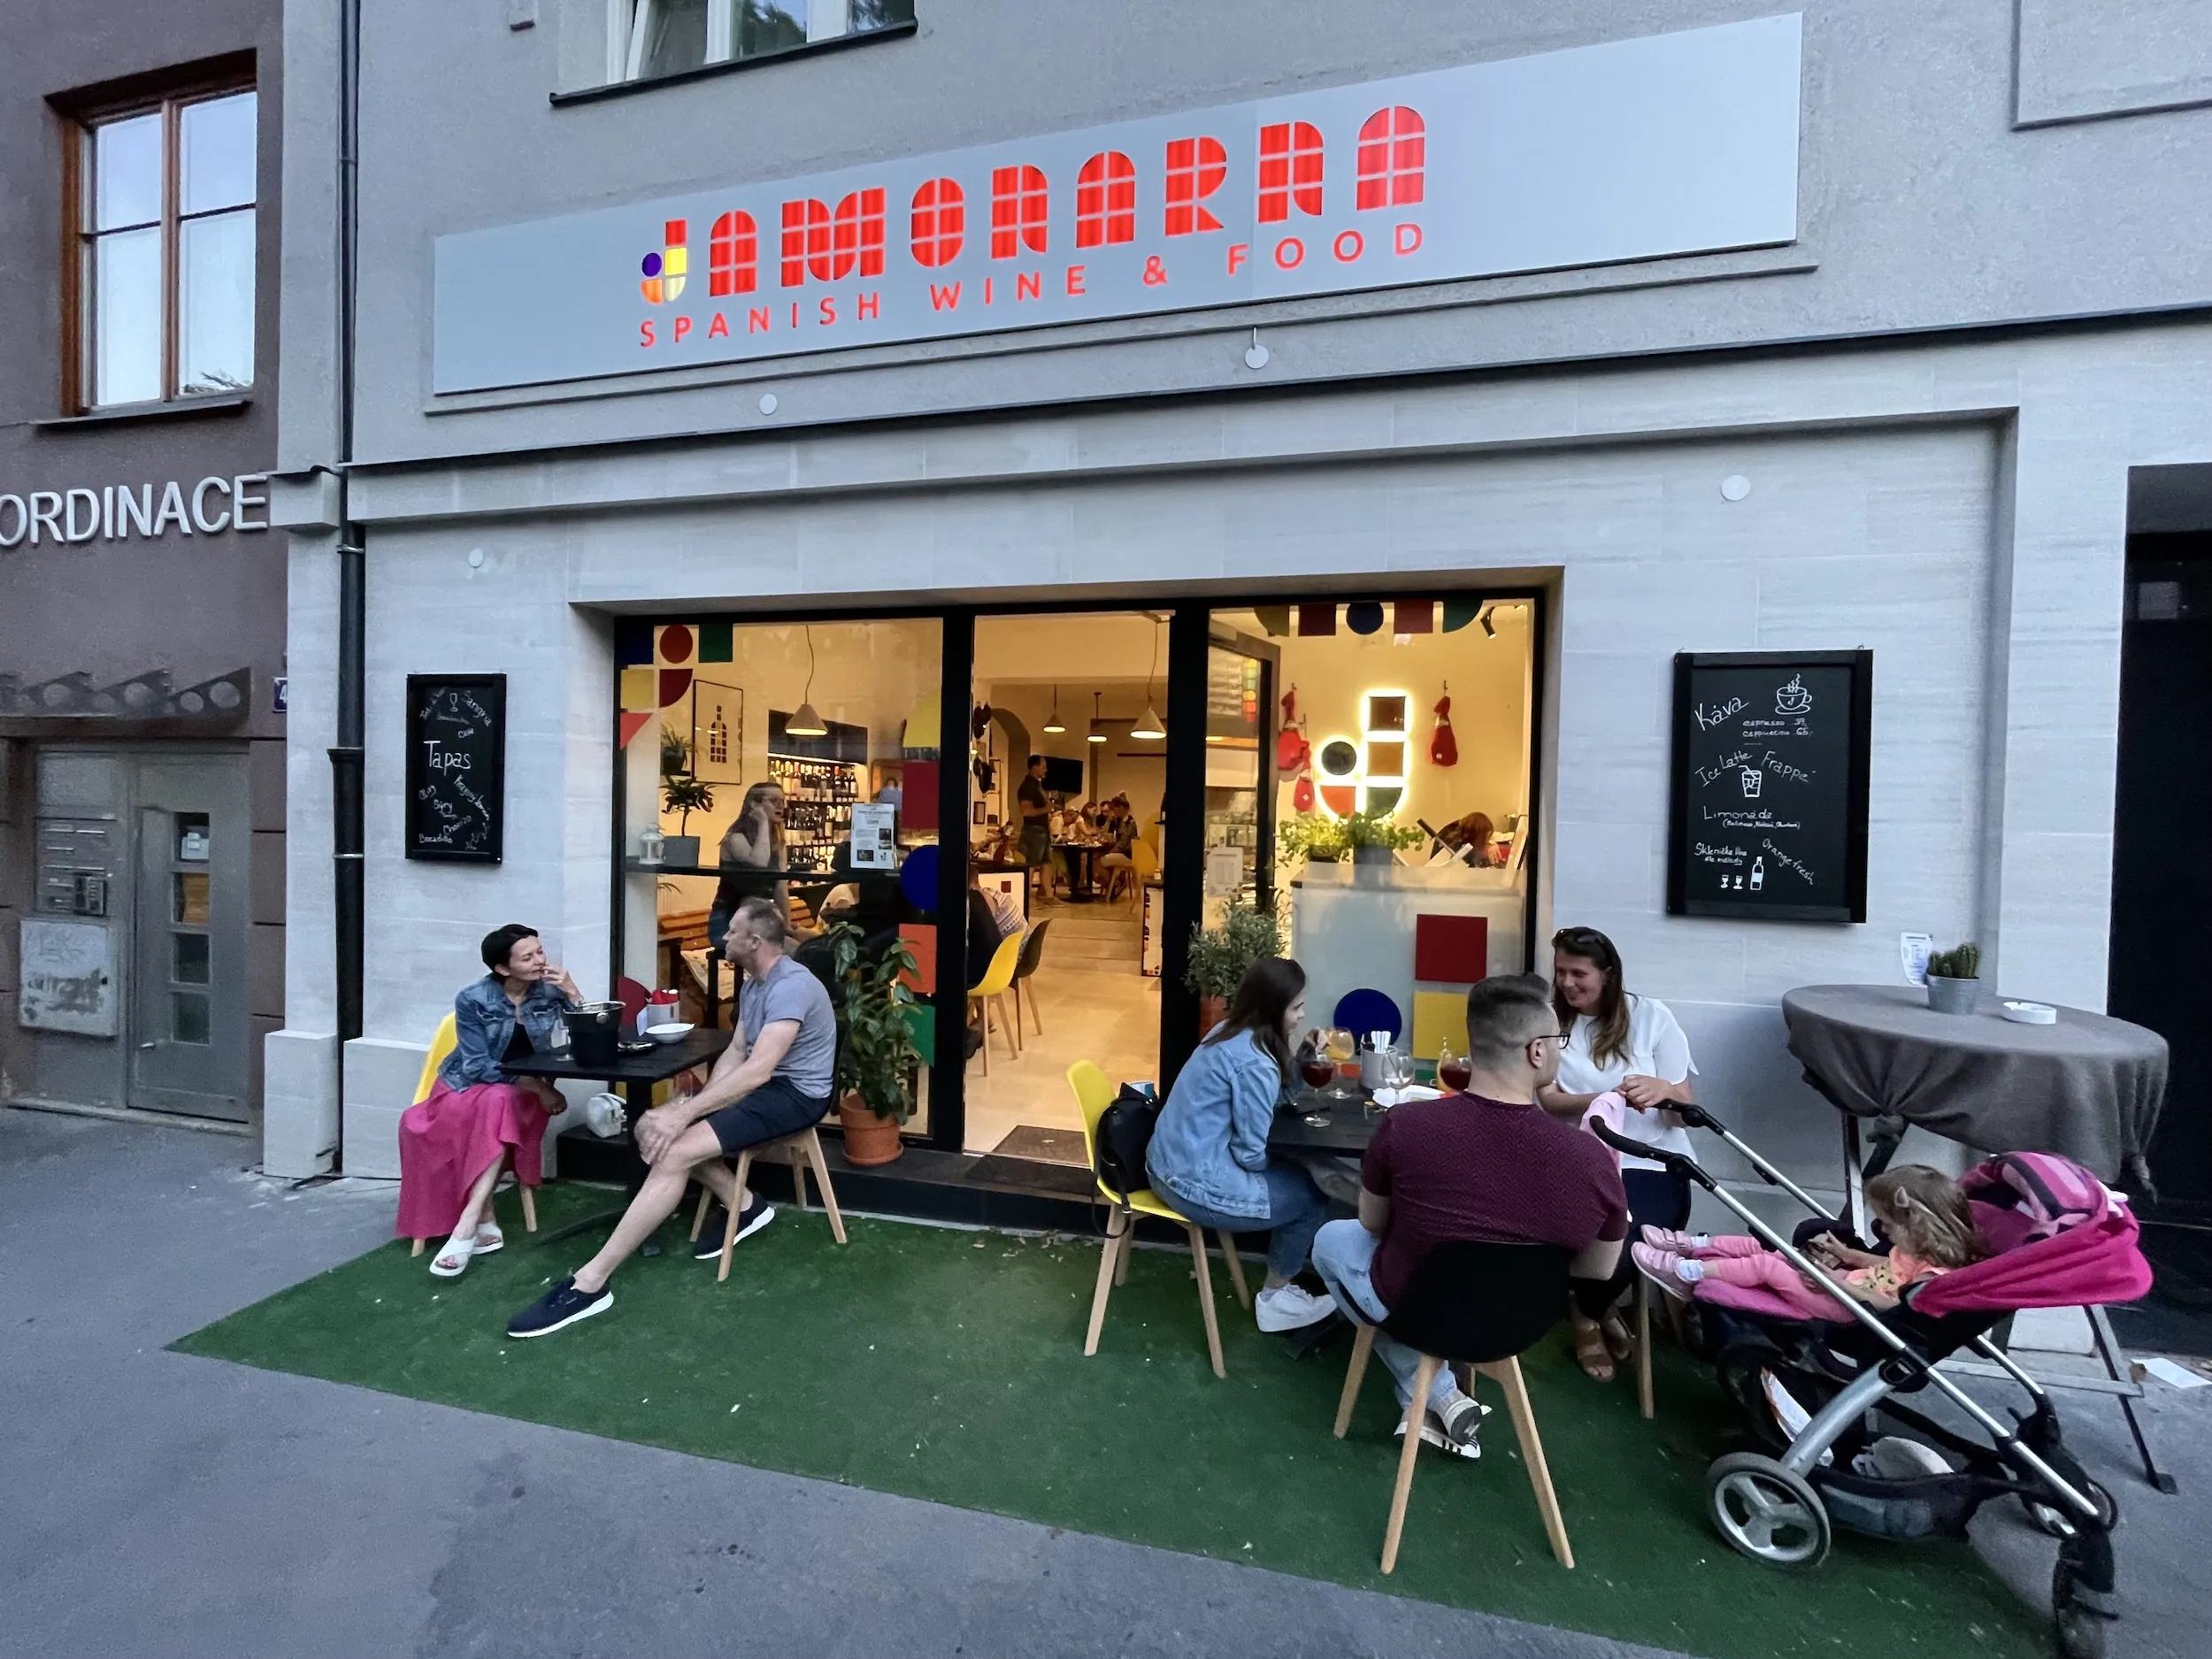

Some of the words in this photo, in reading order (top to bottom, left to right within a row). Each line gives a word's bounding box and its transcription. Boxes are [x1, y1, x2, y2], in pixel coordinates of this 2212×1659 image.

[640, 291, 880, 347] SPANISH
[930, 264, 1087, 311] WINE
[1142, 256, 1167, 285] &
[1227, 222, 1424, 275] FOOD
[0, 473, 266, 546] ORDINACE
[1694, 697, 1750, 732] Káva
[423, 740, 472, 777] Tapas
[1694, 765, 1722, 787] Ice
[1718, 749, 1753, 769] Latte
[1762, 838, 1793, 867] Orange
